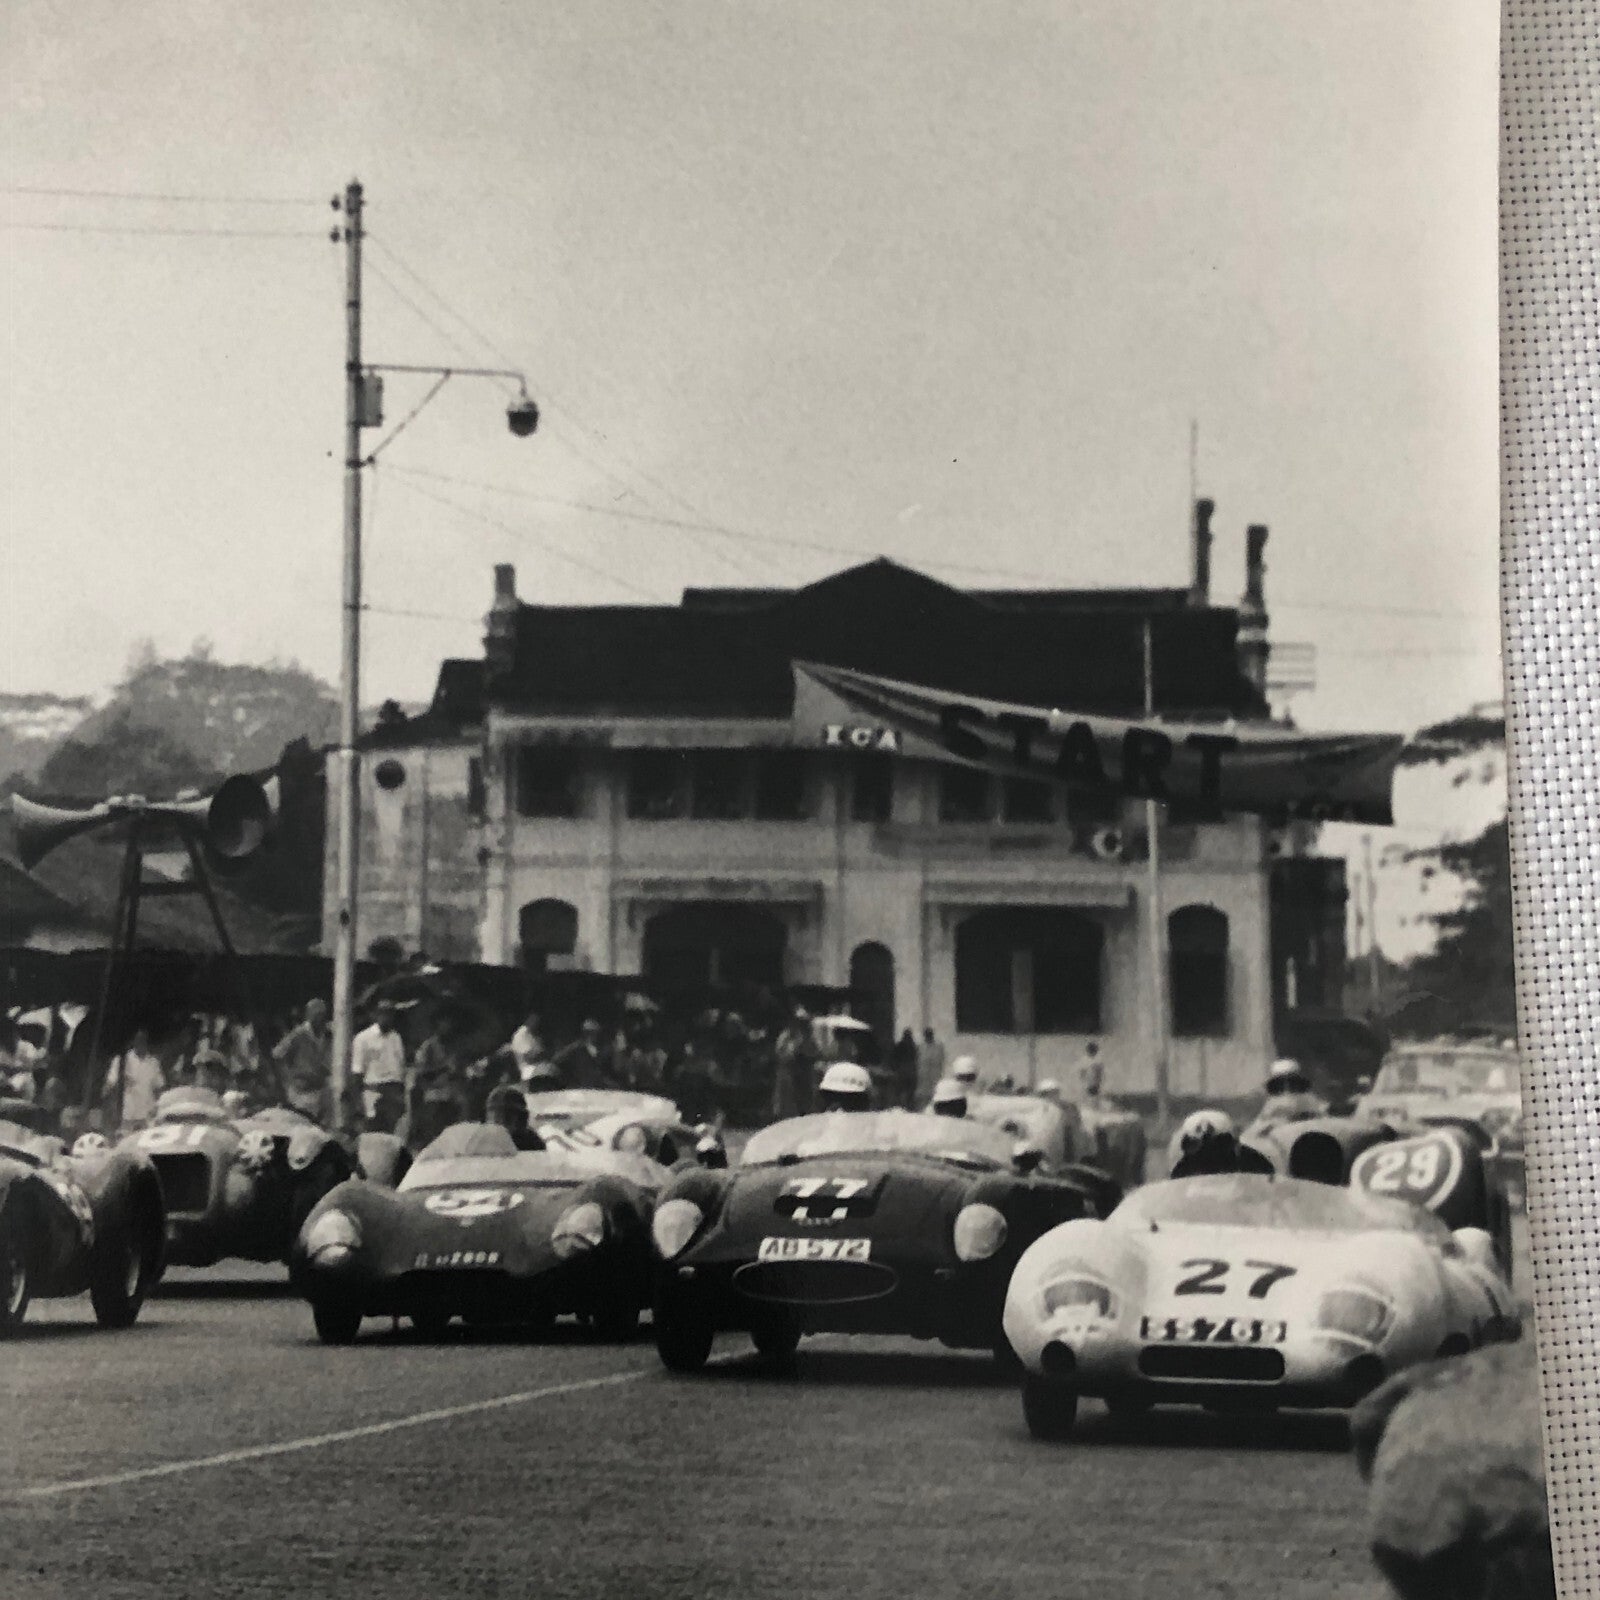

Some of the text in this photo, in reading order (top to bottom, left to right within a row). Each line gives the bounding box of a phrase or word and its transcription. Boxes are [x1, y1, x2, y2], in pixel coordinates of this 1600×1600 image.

[939, 703, 1237, 804] START
[1369, 1145, 1439, 1189] 29
[789, 1178, 868, 1220] 77
[1173, 1257, 1298, 1299] 27
